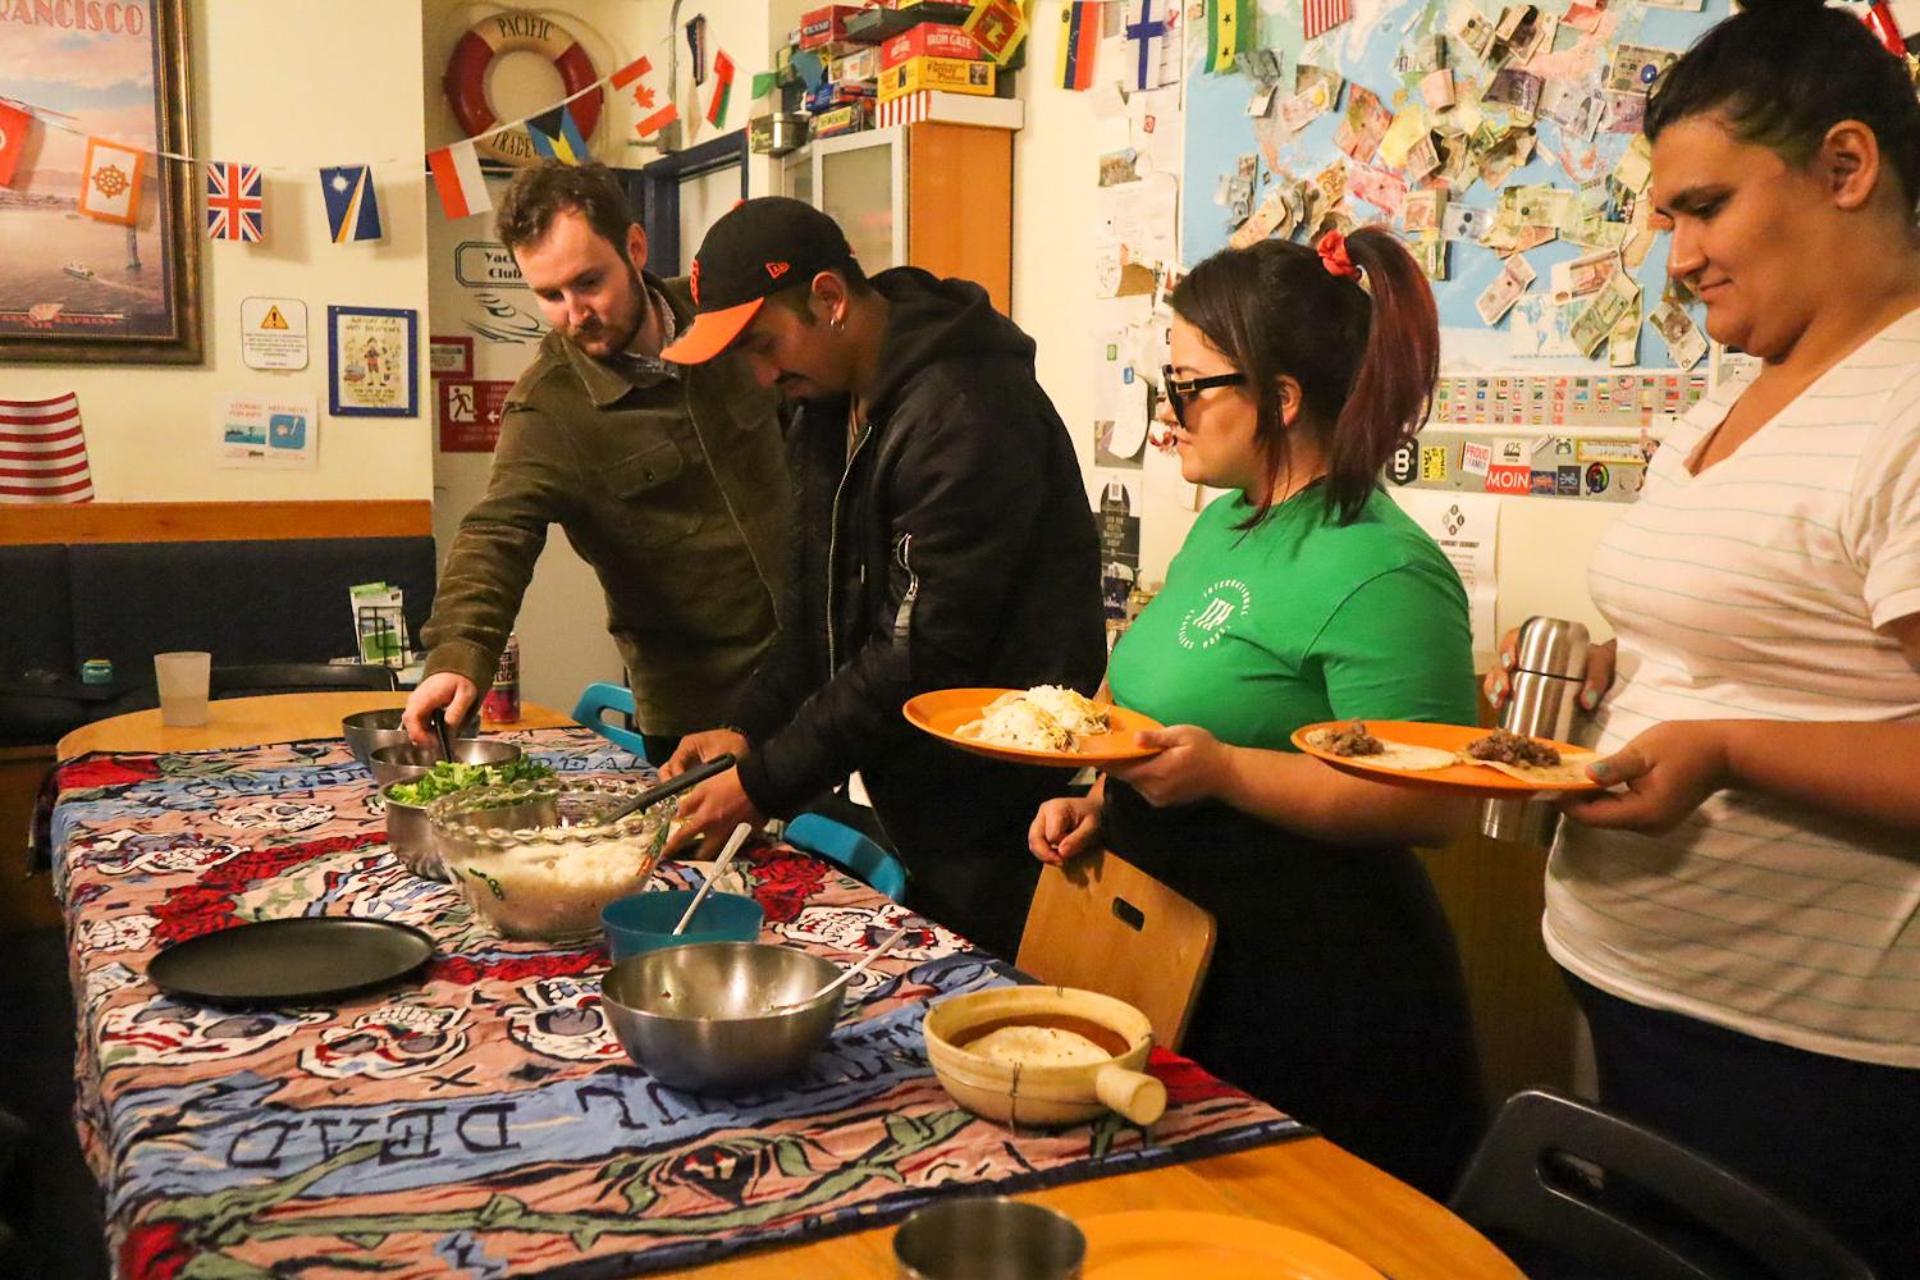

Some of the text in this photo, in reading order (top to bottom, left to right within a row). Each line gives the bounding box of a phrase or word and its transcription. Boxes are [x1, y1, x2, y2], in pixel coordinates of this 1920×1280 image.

[498, 16, 552, 41] PACIFIC
[492, 131, 538, 159] TRADE
[1486, 471, 1529, 489] MOIN
[225, 1101, 522, 1169] DEAD
